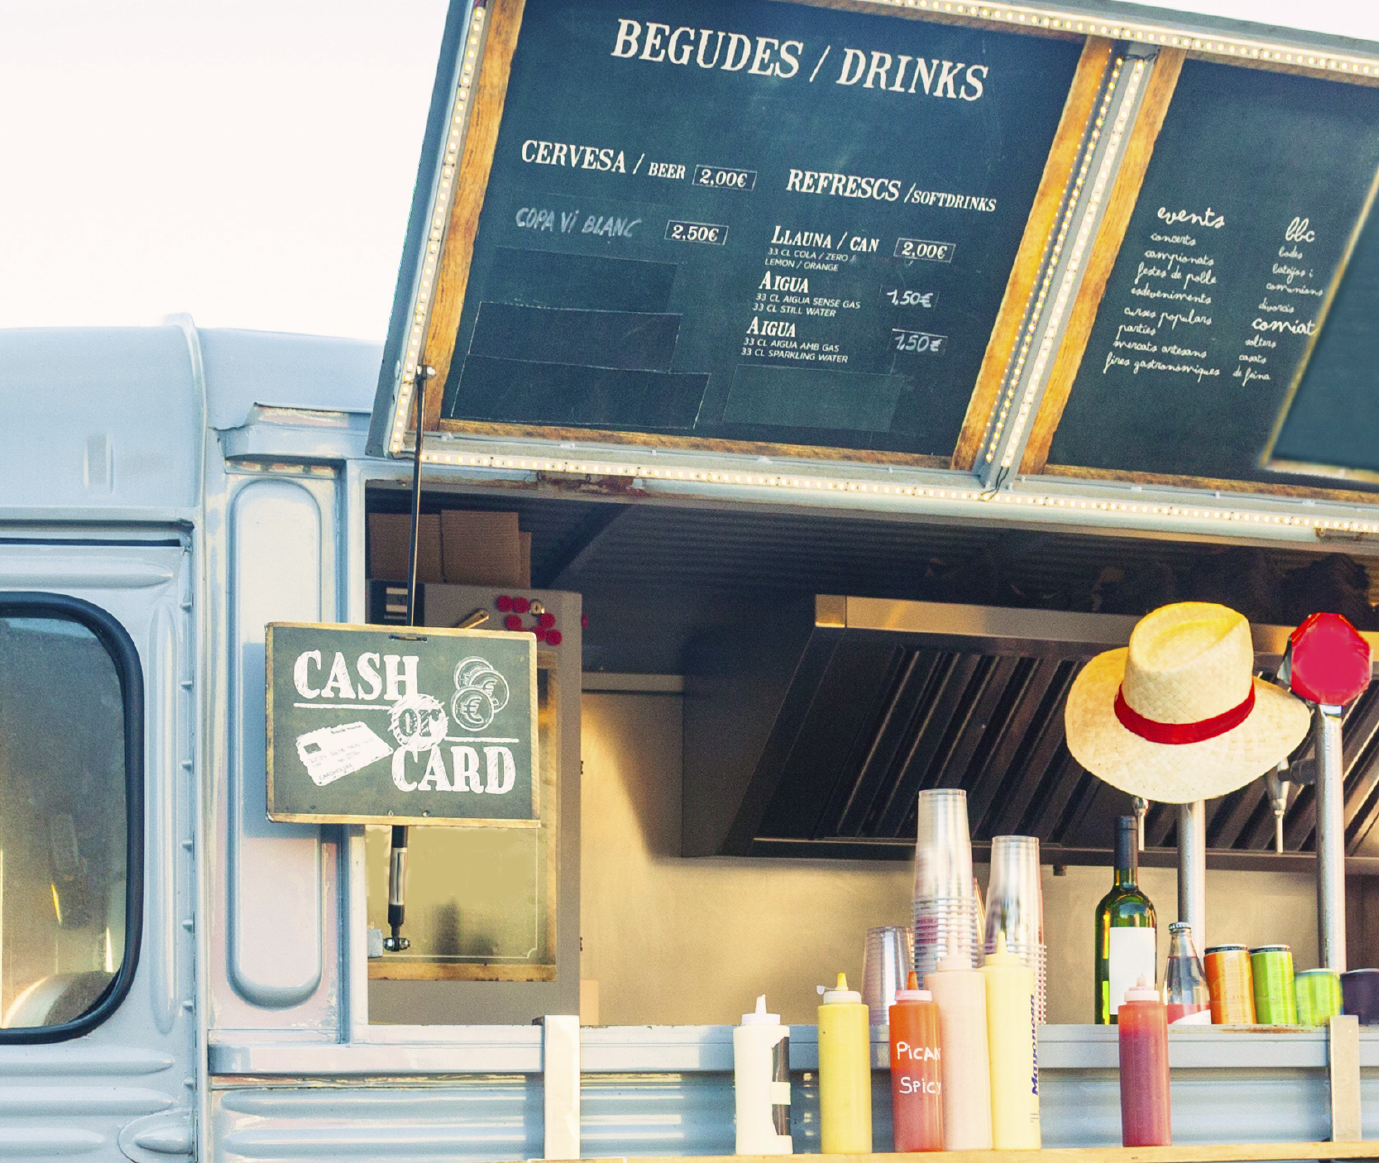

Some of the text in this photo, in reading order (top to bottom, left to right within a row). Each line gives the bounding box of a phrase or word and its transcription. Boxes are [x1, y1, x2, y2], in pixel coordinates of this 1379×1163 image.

[610, 18, 804, 79] BEGUDES
[835, 47, 990, 102] DRINKS
[521, 139, 627, 174] CERVESA
[648, 162, 686, 180] BEER
[785, 168, 902, 202] REFRESCS
[515, 207, 555, 233] COPA
[582, 214, 643, 238] BLANC
[1157, 206, 1225, 229] events
[1150, 232, 1196, 246] concerts
[1285, 216, 1315, 242] bbc
[768, 247, 779, 256] 33
[781, 249, 791, 257] CL
[794, 250, 817, 260] COLA
[825, 253, 849, 262] ZERO
[849, 236, 880, 253] CAN
[765, 258, 795, 268] LEMON
[804, 261, 839, 272] ORANGE
[1144, 250, 1215, 270] campionats
[1134, 261, 1217, 290] festes de poble
[1131, 282, 1212, 304] esdeveniments
[1266, 282, 1323, 297] comunions
[752, 303, 837, 318] 33 CL STILL WATER
[756, 293, 861, 310] 33 CL AIGUA SENSE GAS
[1124, 307, 1212, 330] curses populars
[1115, 323, 1156, 340] parties
[741, 347, 849, 363] 33 CL SPARKLING WATER
[743, 337, 840, 353] 33 CL AIGUA AMB GAS
[1113, 341, 1207, 358] mercats artesans
[1103, 351, 1130, 374] fires
[1232, 365, 1271, 387] de feina
[293, 649, 420, 701] CASH
[391, 745, 517, 795] CARD
